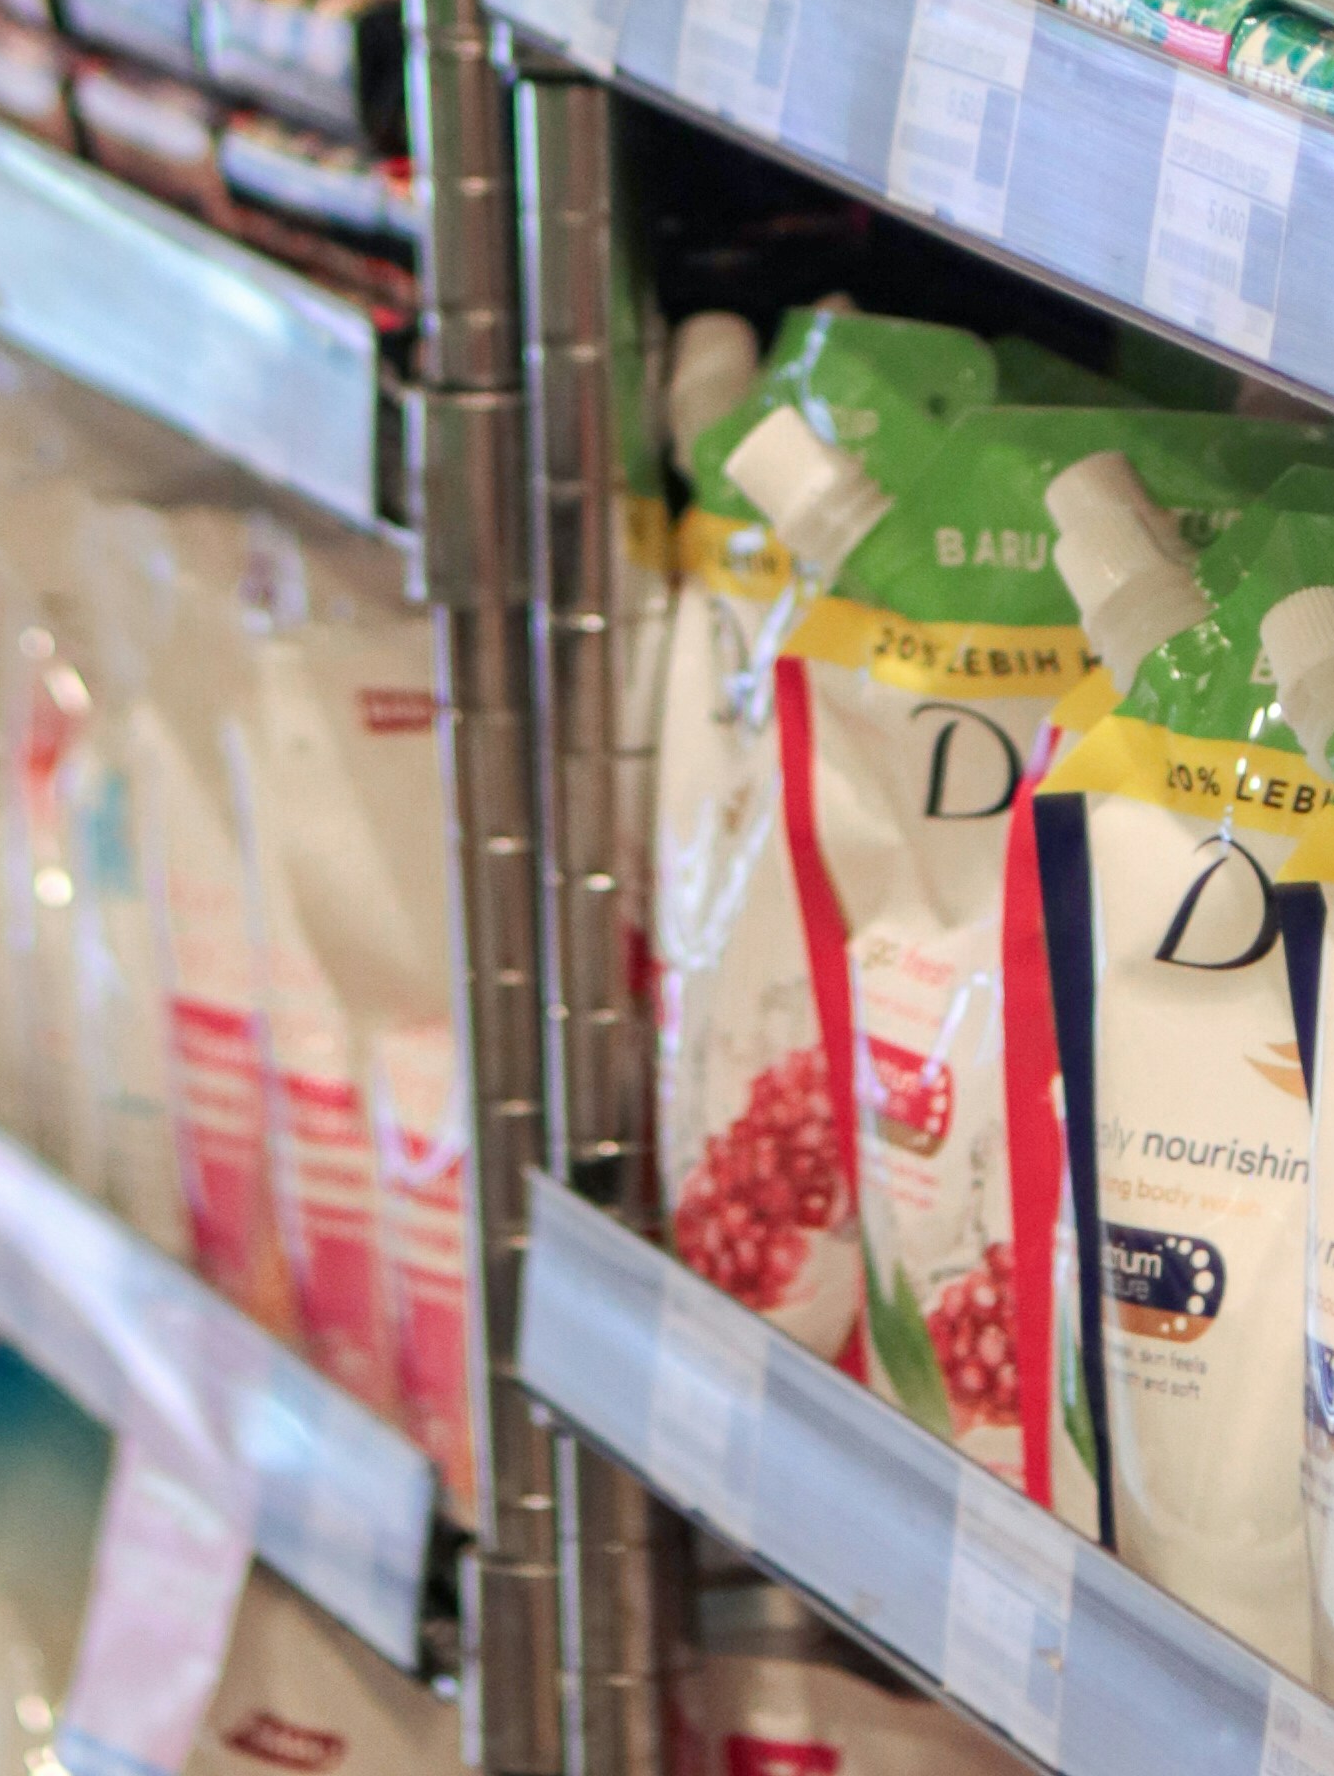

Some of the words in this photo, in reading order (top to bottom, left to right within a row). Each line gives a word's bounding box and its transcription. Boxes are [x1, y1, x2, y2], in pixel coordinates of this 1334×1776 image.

[935, 526, 1048, 572] BARU
[947, 646, 1061, 678] LEBIH
[1142, 1130, 1310, 1185] nourishin
[1137, 1177, 1192, 1209] body
[1169, 1345, 1208, 1376] feels
[1169, 1375, 1202, 1400] soft
